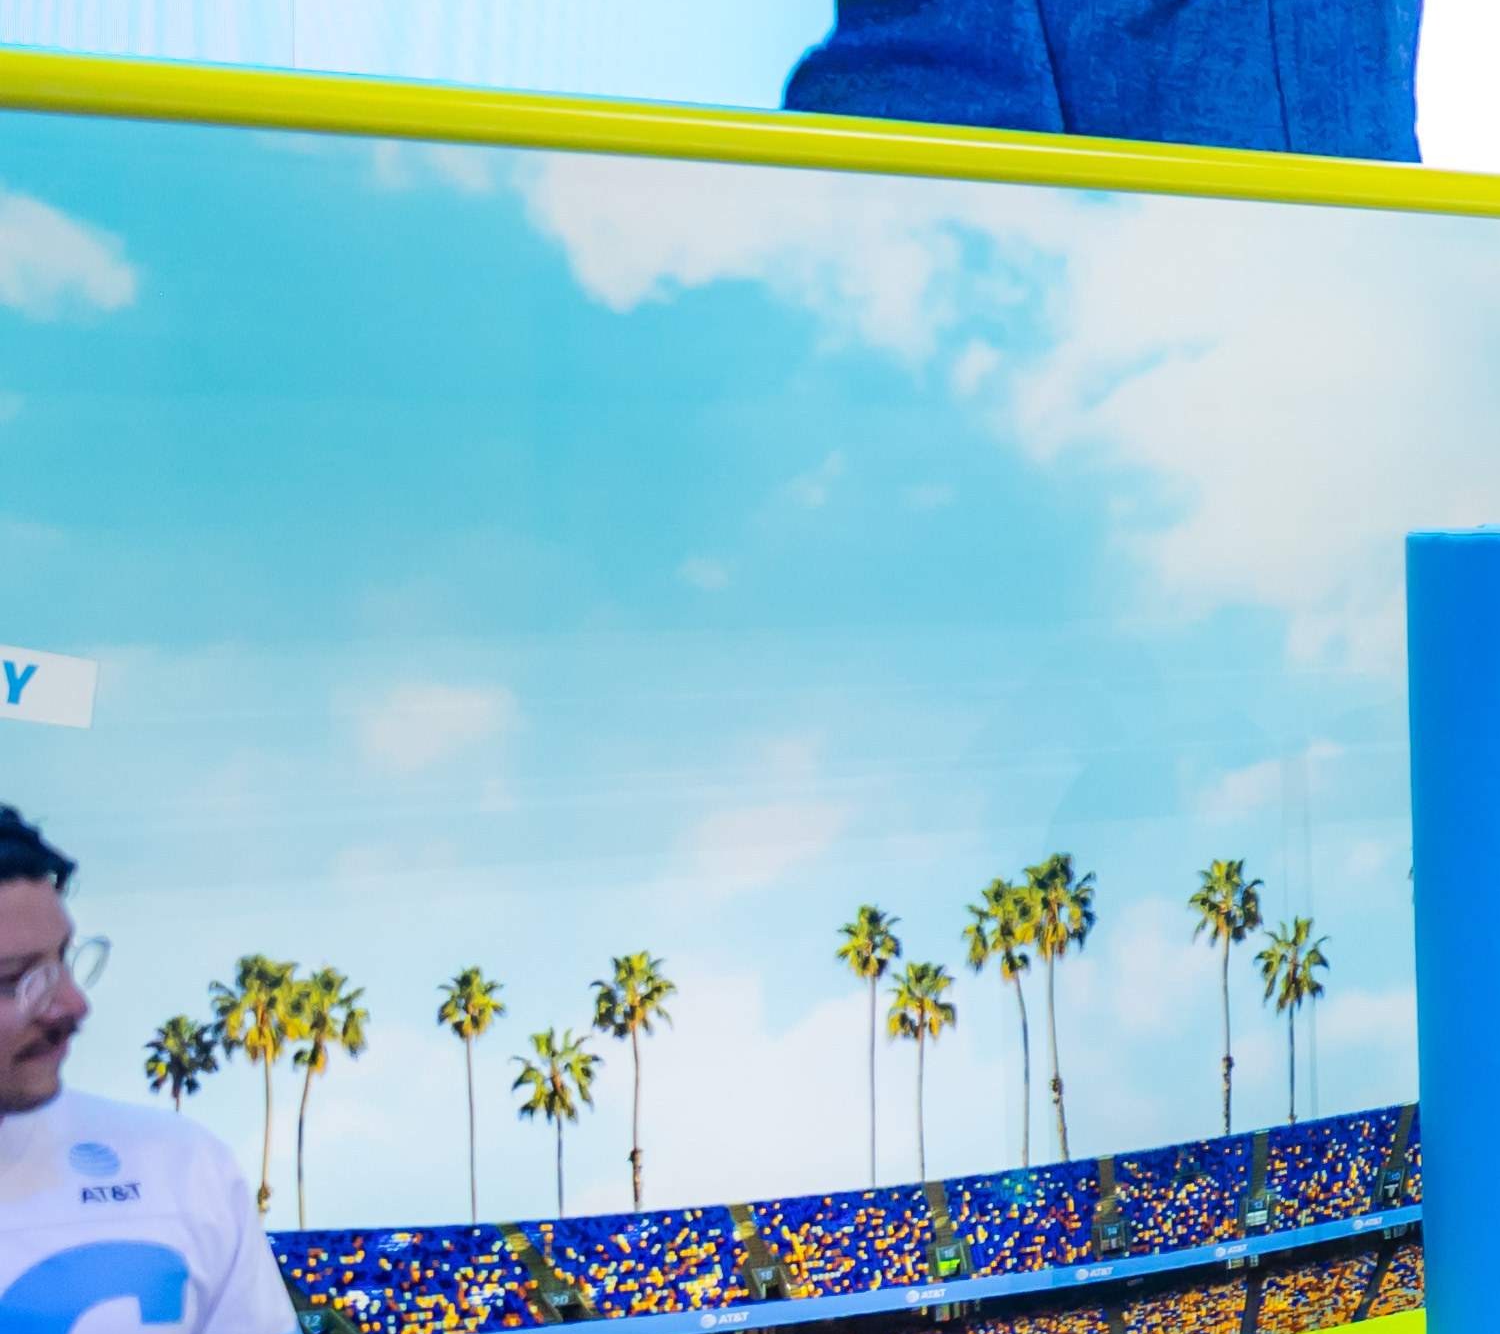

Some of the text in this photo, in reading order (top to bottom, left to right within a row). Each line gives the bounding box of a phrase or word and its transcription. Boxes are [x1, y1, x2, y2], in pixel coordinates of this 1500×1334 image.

[2, 660, 39, 705] Y
[80, 1180, 142, 1204] AT&T
[920, 1288, 947, 1299] AT&T
[718, 1311, 750, 1326] AT&T
